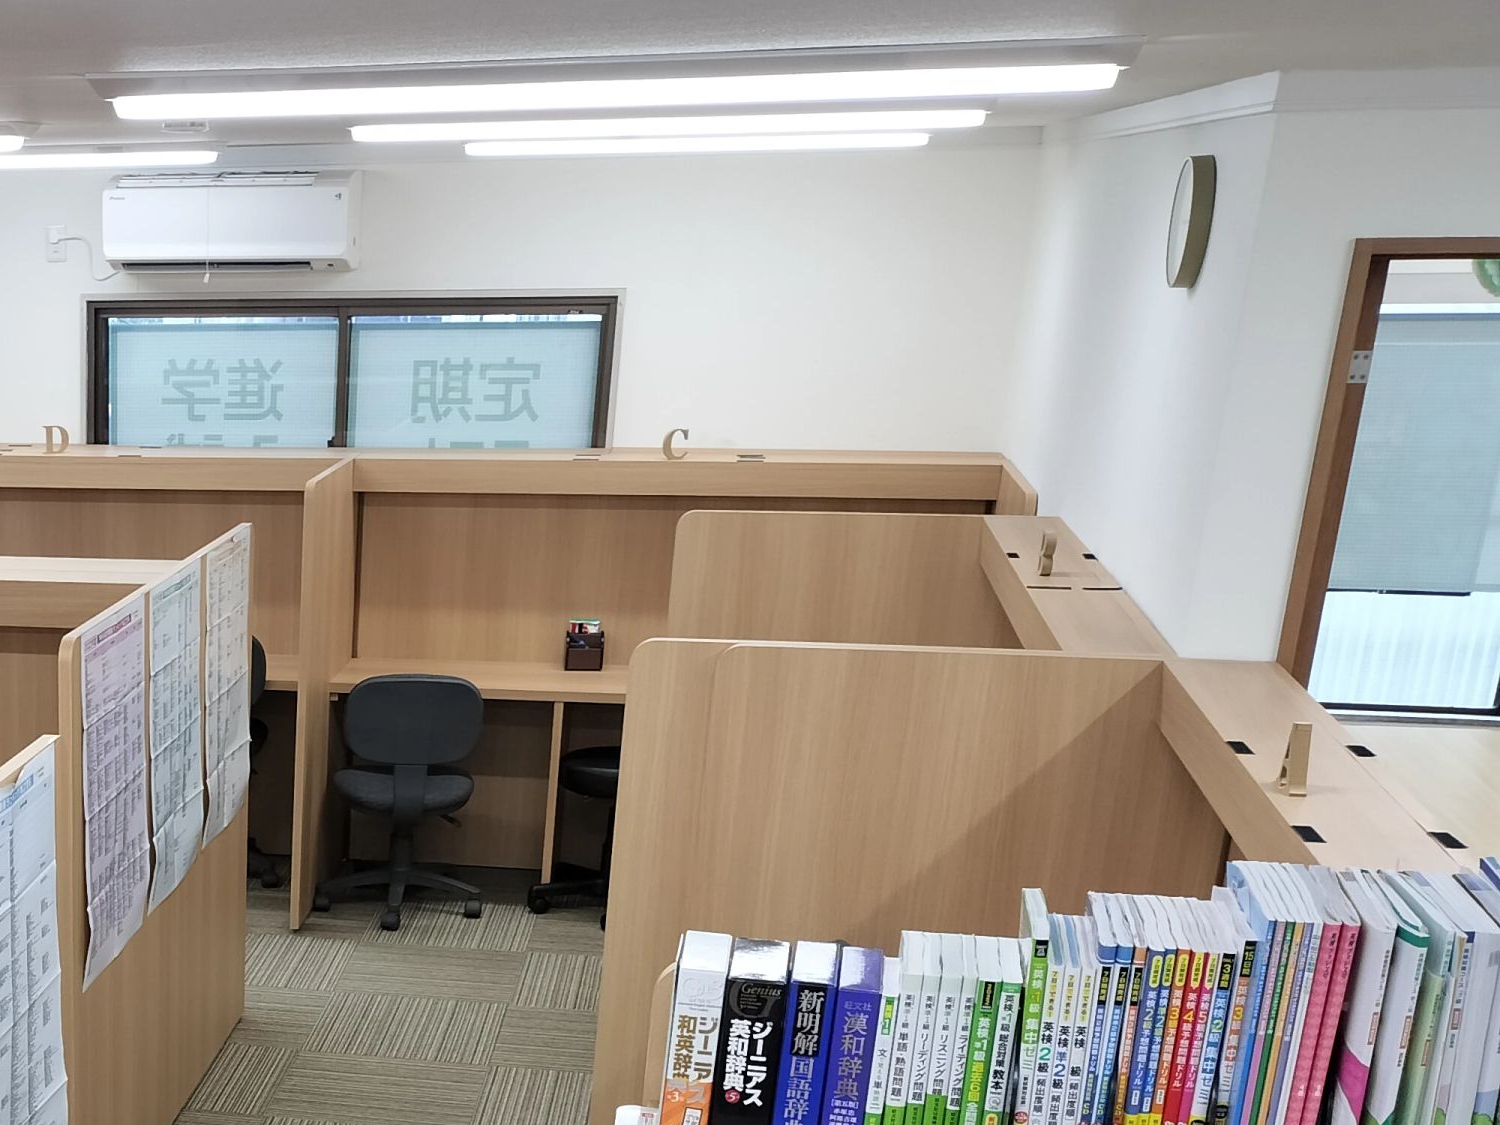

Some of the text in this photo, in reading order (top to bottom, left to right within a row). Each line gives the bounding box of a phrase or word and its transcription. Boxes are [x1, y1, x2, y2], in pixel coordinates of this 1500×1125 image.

[42, 425, 69, 455] D
[662, 428, 690, 460] C
[741, 983, 782, 997] Genius
[844, 1001, 872, 1012] 旺文社
[1022, 1018, 1038, 1071] 集中ゼミ
[1037, 1021, 1054, 1073] 英検2級
[1208, 997, 1227, 1044] 英検2級
[723, 1018, 751, 1092] 英和辞典
[743, 1021, 773, 1107] ジーニアス
[833, 1011, 868, 1101] 漢和辞典
[911, 1033, 929, 1102] リーディング問題
[932, 1034, 949, 1096] リスニング問題
[949, 1034, 969, 1108] ライティング問題
[1051, 1025, 1071, 1090] 英検準2級
